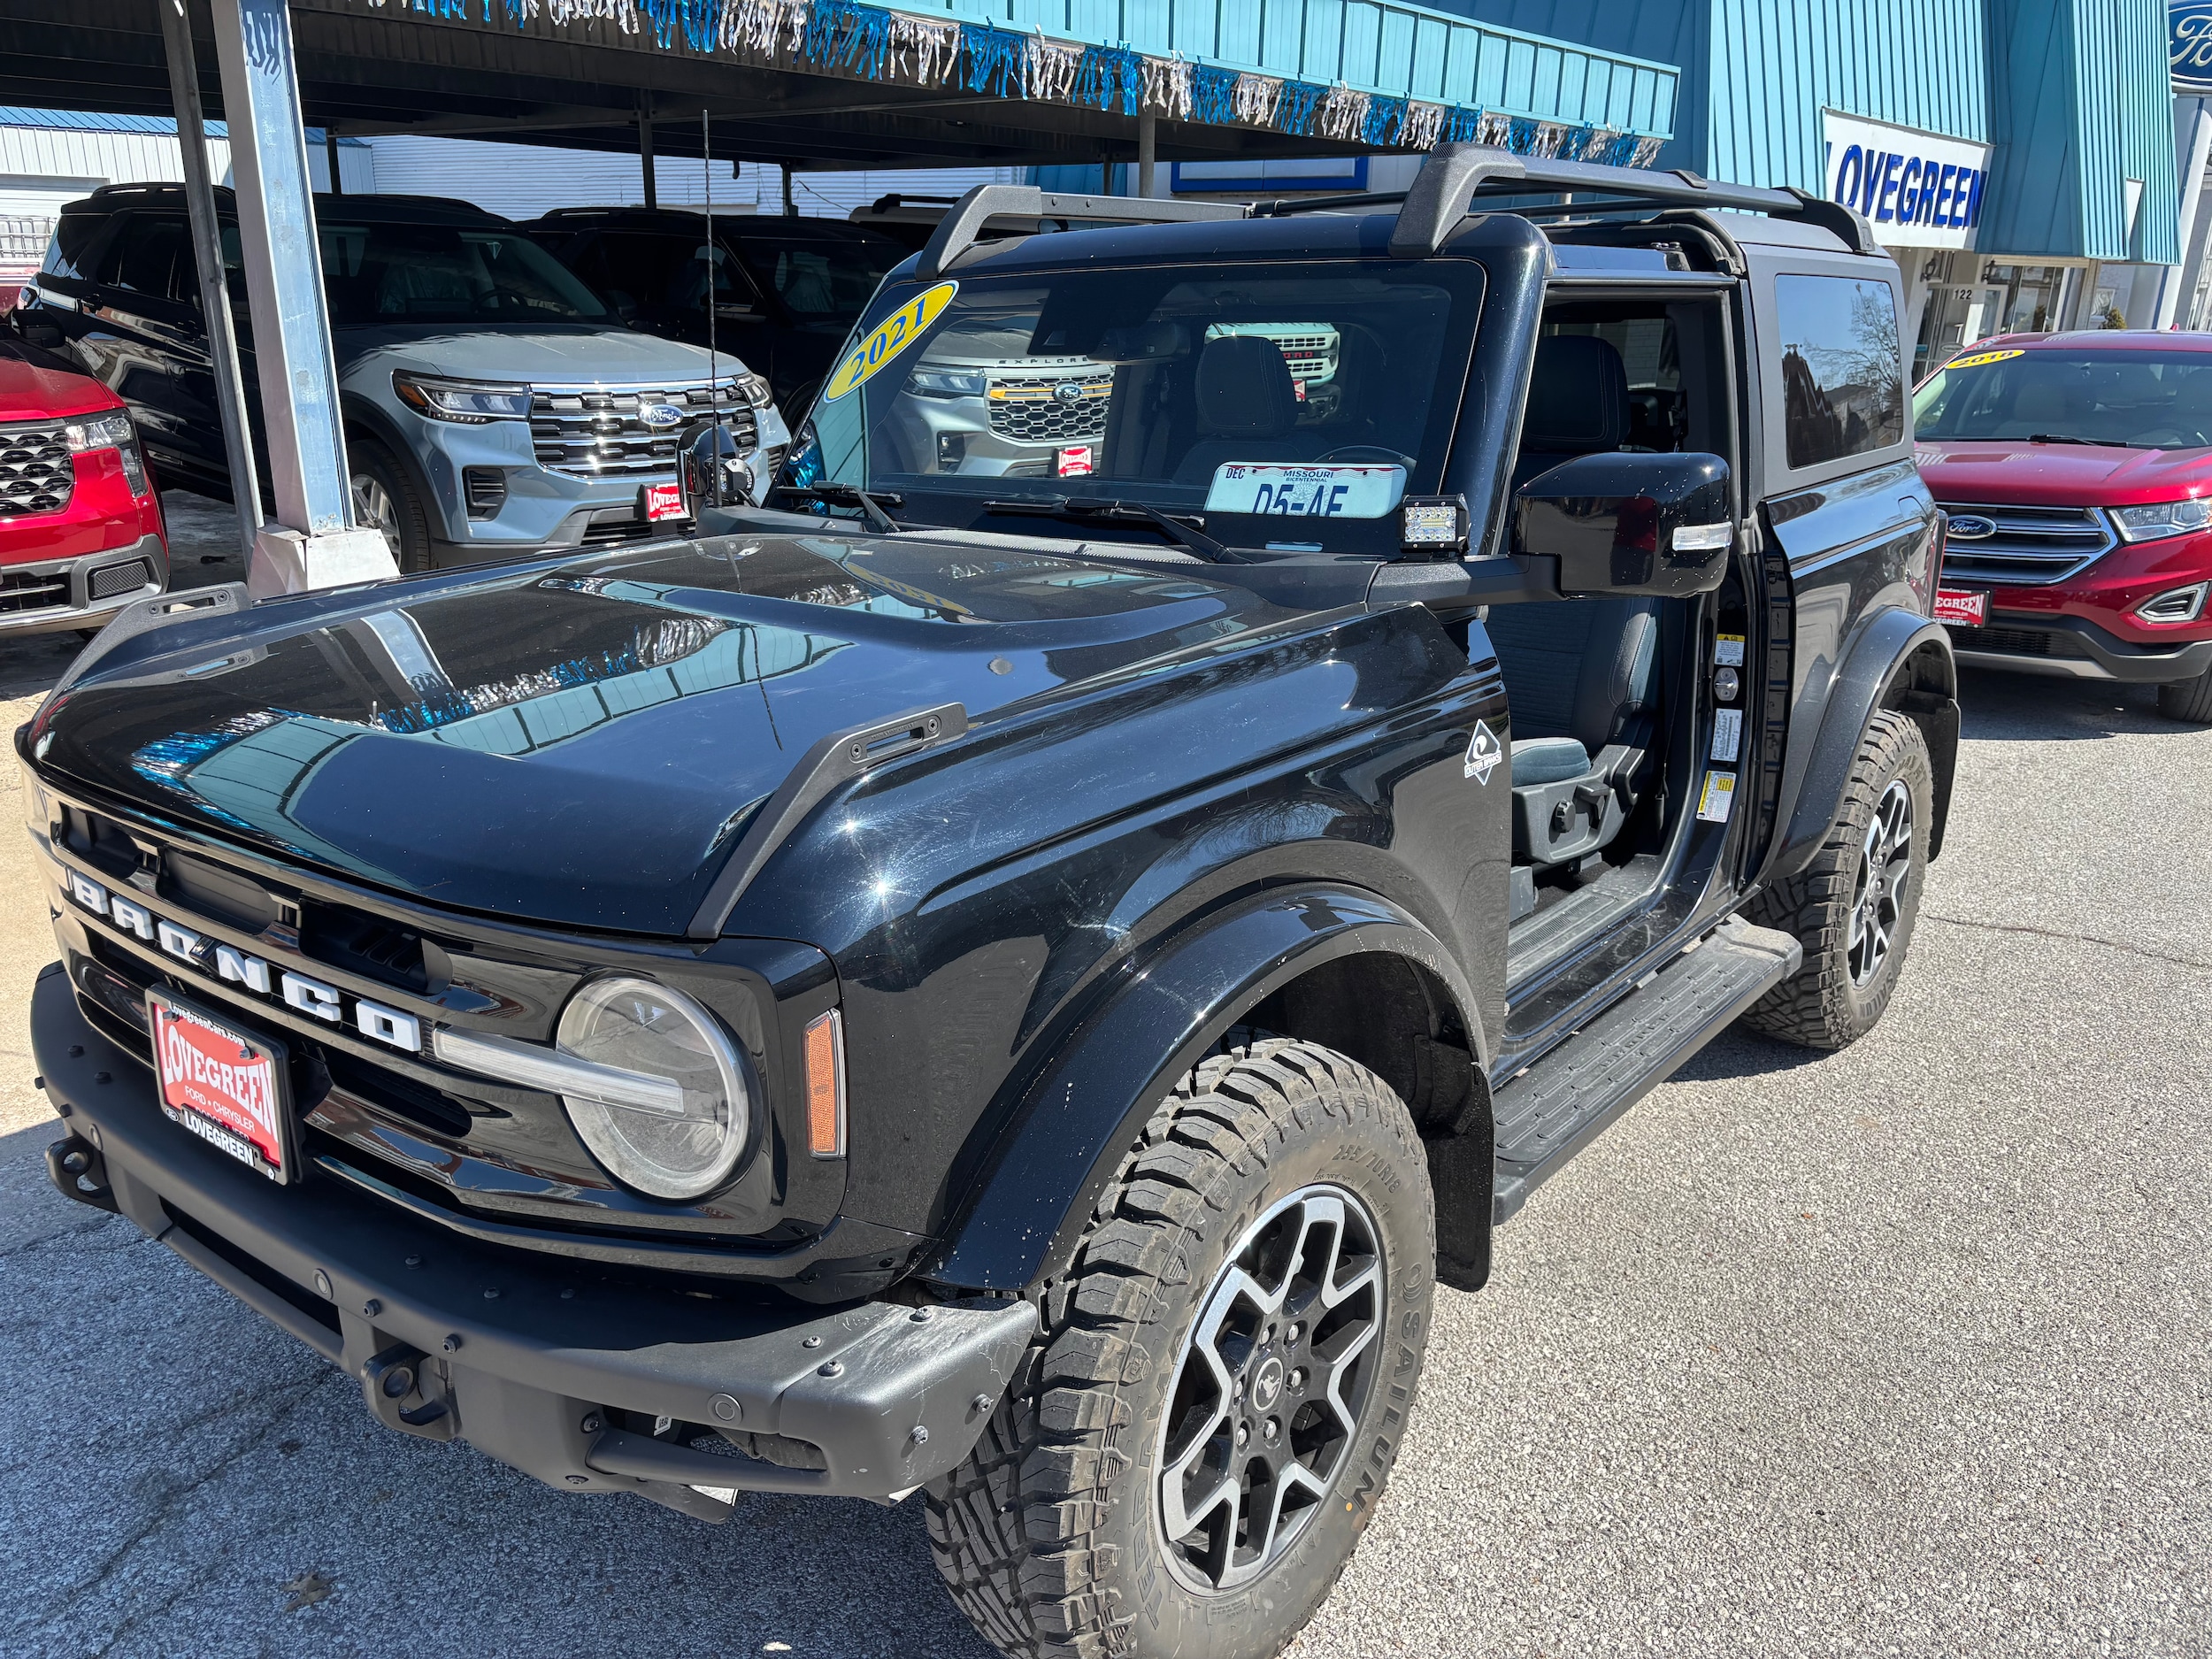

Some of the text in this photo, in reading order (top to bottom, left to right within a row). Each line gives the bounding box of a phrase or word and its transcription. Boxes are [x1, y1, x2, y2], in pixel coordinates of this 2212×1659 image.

[1826, 142, 1987, 229] OVEGREEN
[1954, 289, 1972, 299] 122
[848, 296, 926, 388] 2021
[1225, 467, 1244, 480] DEC
[1283, 470, 1333, 479] MISSOURI
[1949, 519, 1982, 533] Ford
[1935, 594, 1985, 617] EGREEN
[1465, 760, 1484, 775] OUTER
[1483, 751, 1501, 768] BANKS
[72, 872, 422, 1052] BRONCO
[168, 1001, 246, 1048] LovegreenCars.com
[155, 1005, 279, 1142] LOVEGREEN
[184, 1085, 256, 1133] FORD CHRYSLER
[184, 1110, 255, 1167] LOVEGREEN
[1350, 1310, 1422, 1513] SAILUN
